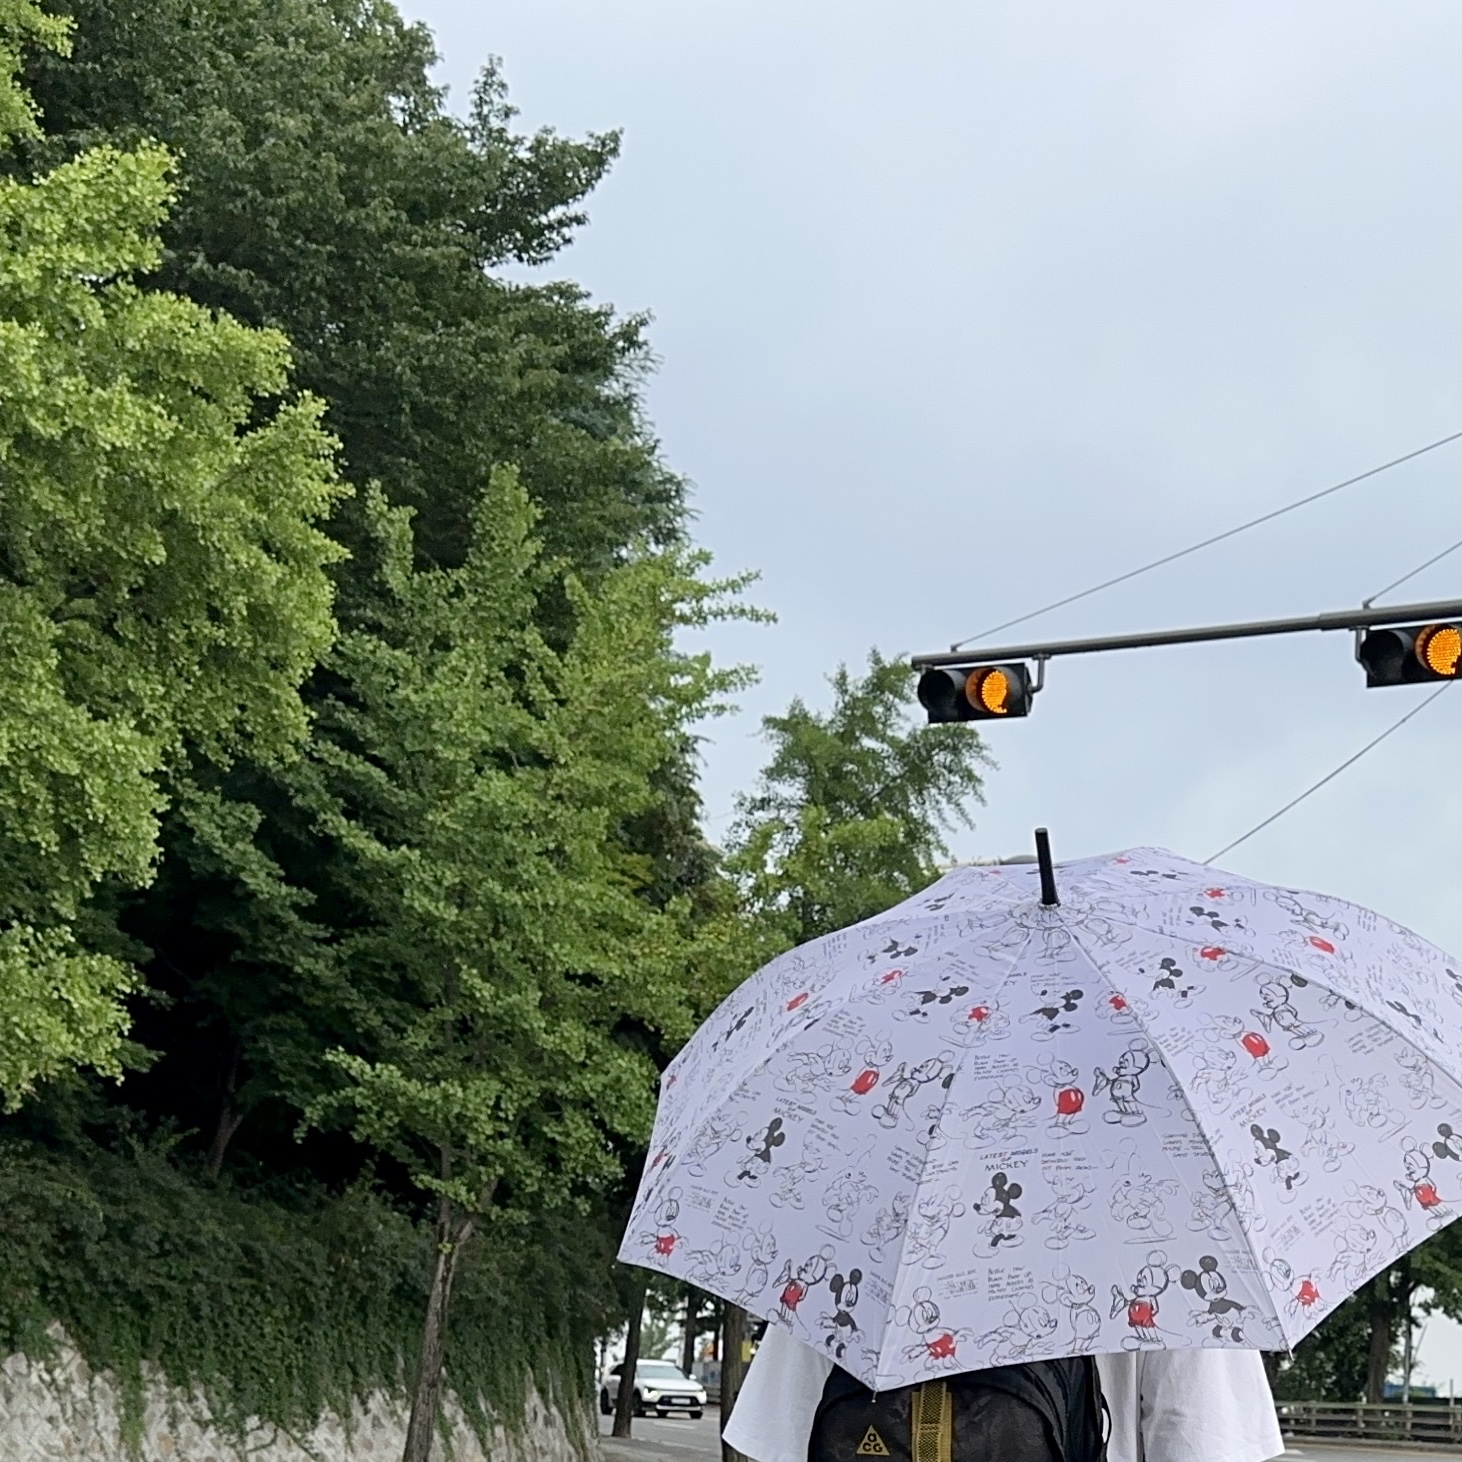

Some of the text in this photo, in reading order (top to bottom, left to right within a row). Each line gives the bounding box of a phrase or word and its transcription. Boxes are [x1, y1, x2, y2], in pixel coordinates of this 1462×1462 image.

[773, 1107, 804, 1123] MICKEY
[1239, 1106, 1267, 1129] MICKEY
[980, 1151, 1008, 1160] LATEST
[984, 1160, 1028, 1171] MICKEY
